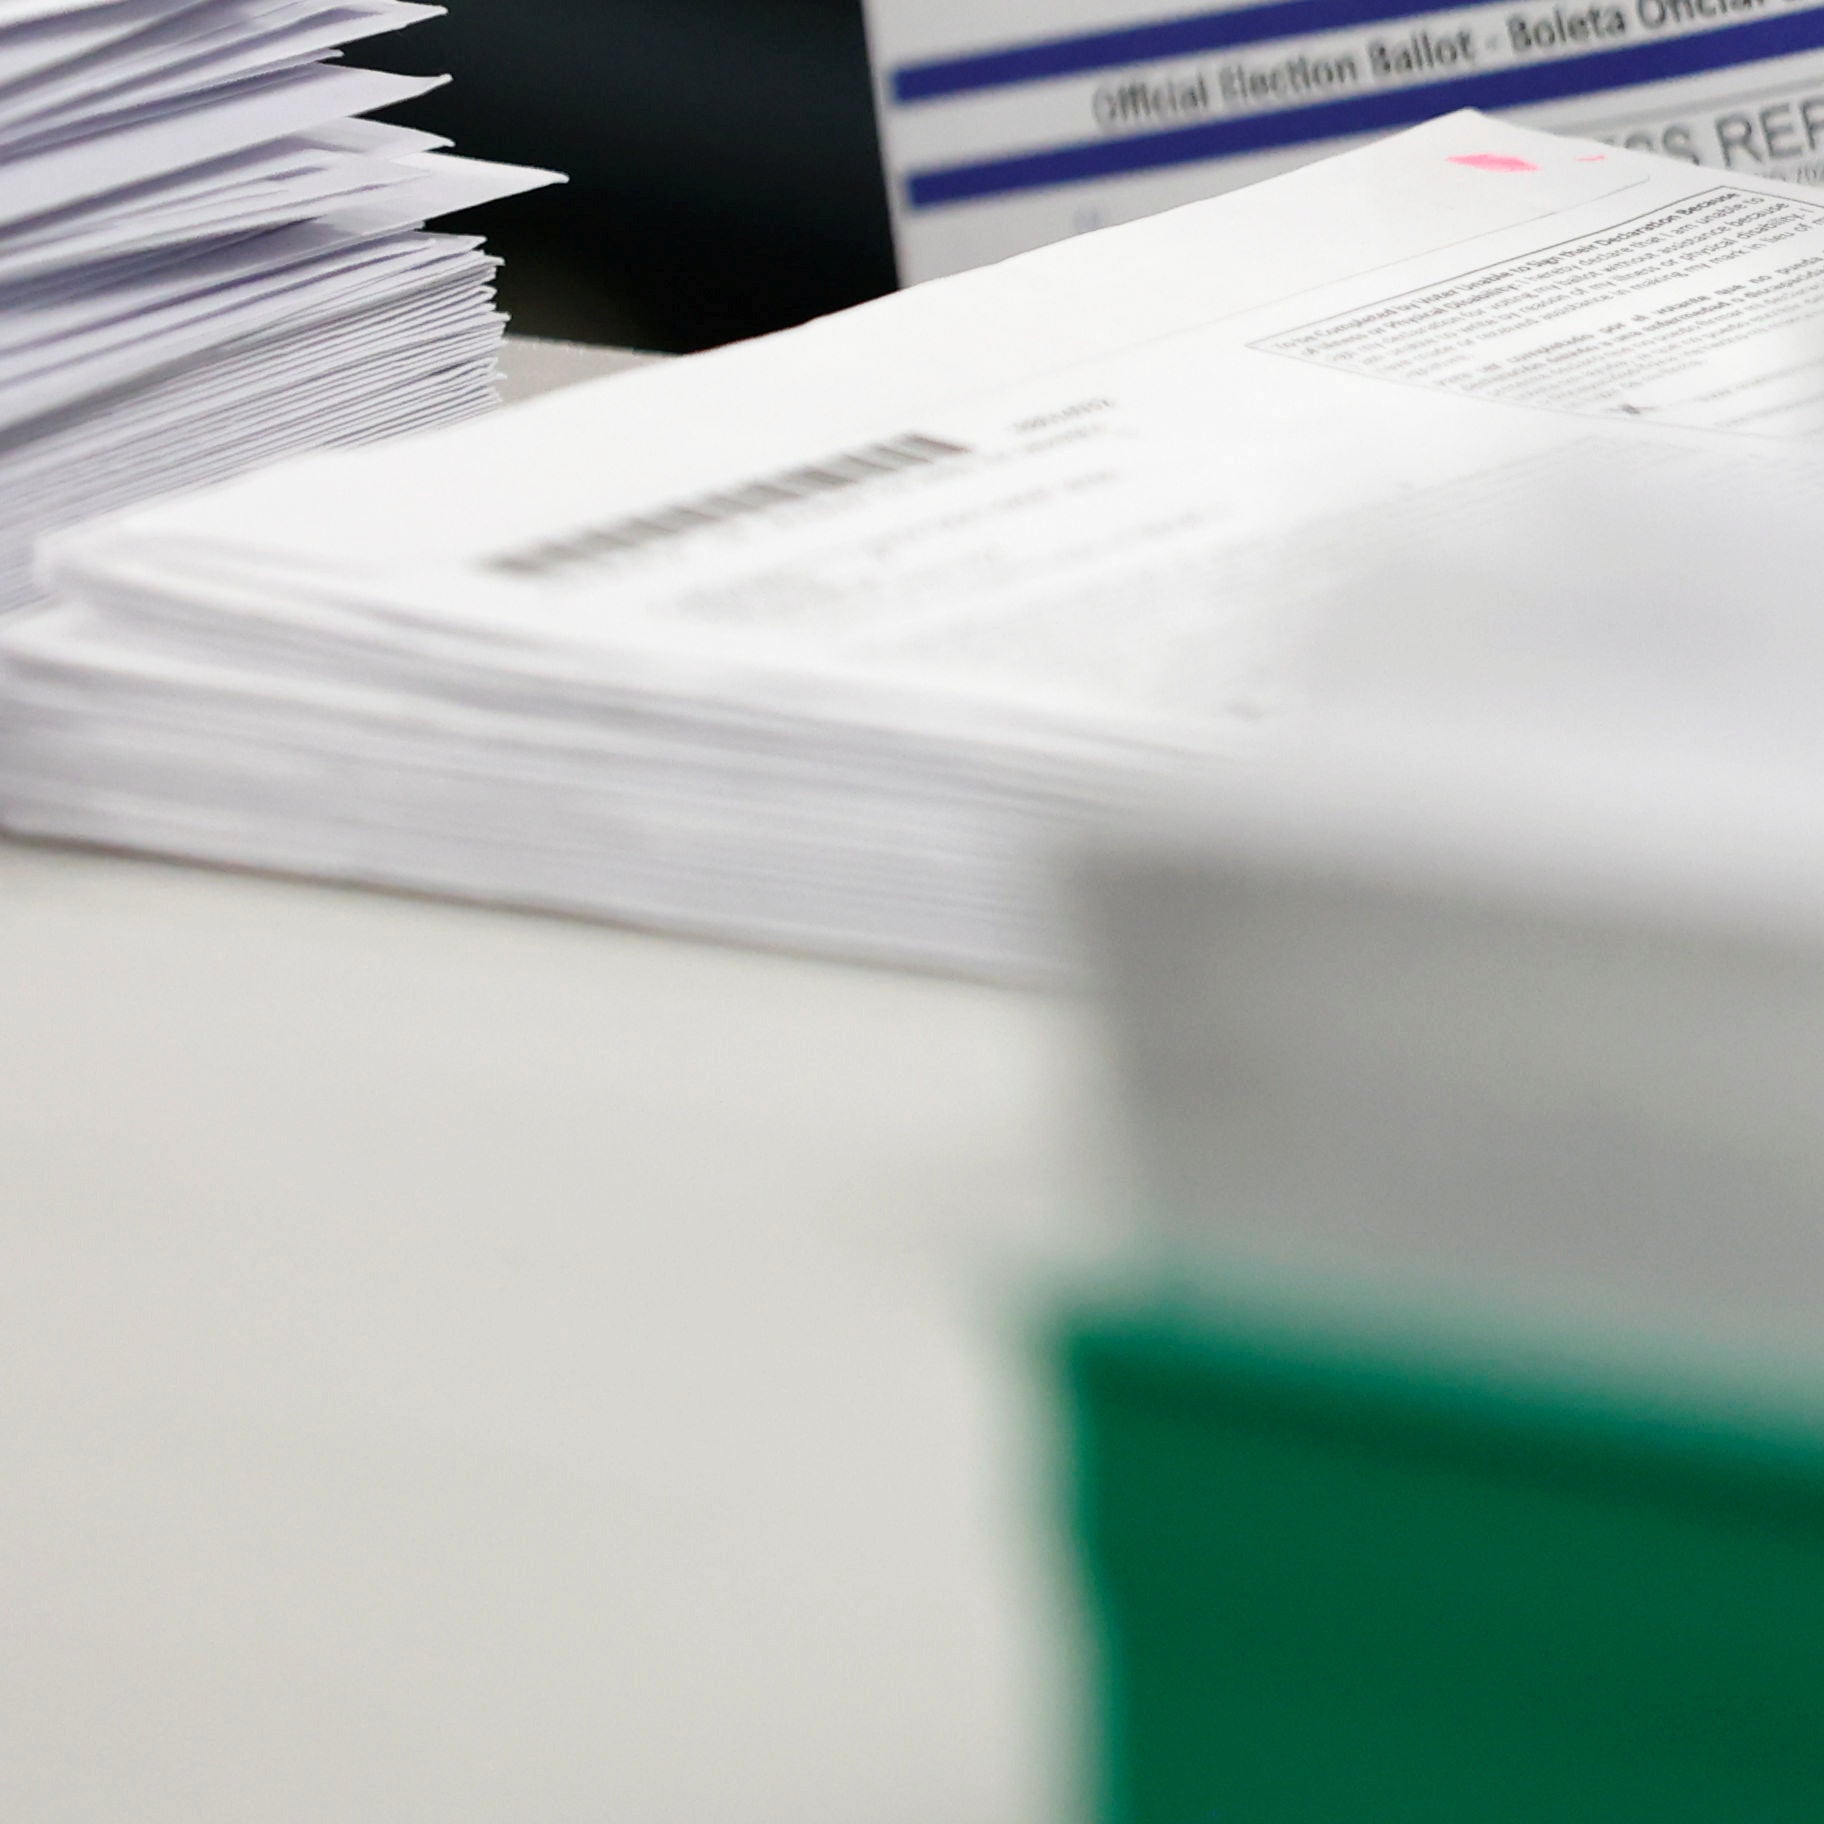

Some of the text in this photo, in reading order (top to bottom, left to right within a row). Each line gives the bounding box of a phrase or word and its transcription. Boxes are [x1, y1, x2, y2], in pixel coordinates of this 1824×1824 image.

[1092, 72, 1208, 122] Official
[1218, 53, 1359, 101] Election
[1367, 28, 1477, 75] Ballot
[1506, 2, 1627, 53] Boleta
[1526, 256, 1563, 268] Sign
[1558, 244, 1598, 258] their
[1594, 215, 1680, 246] Declaration
[1675, 193, 1739, 216] Because
[1578, 247, 1634, 266] declare
[1629, 236, 1666, 248] that
[1671, 223, 1698, 235] am
[1696, 203, 1747, 225] unable
[1657, 226, 1731, 254] assistance
[1725, 203, 1790, 227] because
[1588, 280, 1617, 290] my
[1679, 238, 1738, 261] physical
[1683, 262, 1712, 273] my
[1708, 249, 1750, 264] mark
[1748, 275, 1773, 284] no
[1775, 256, 1824, 275] pueda
